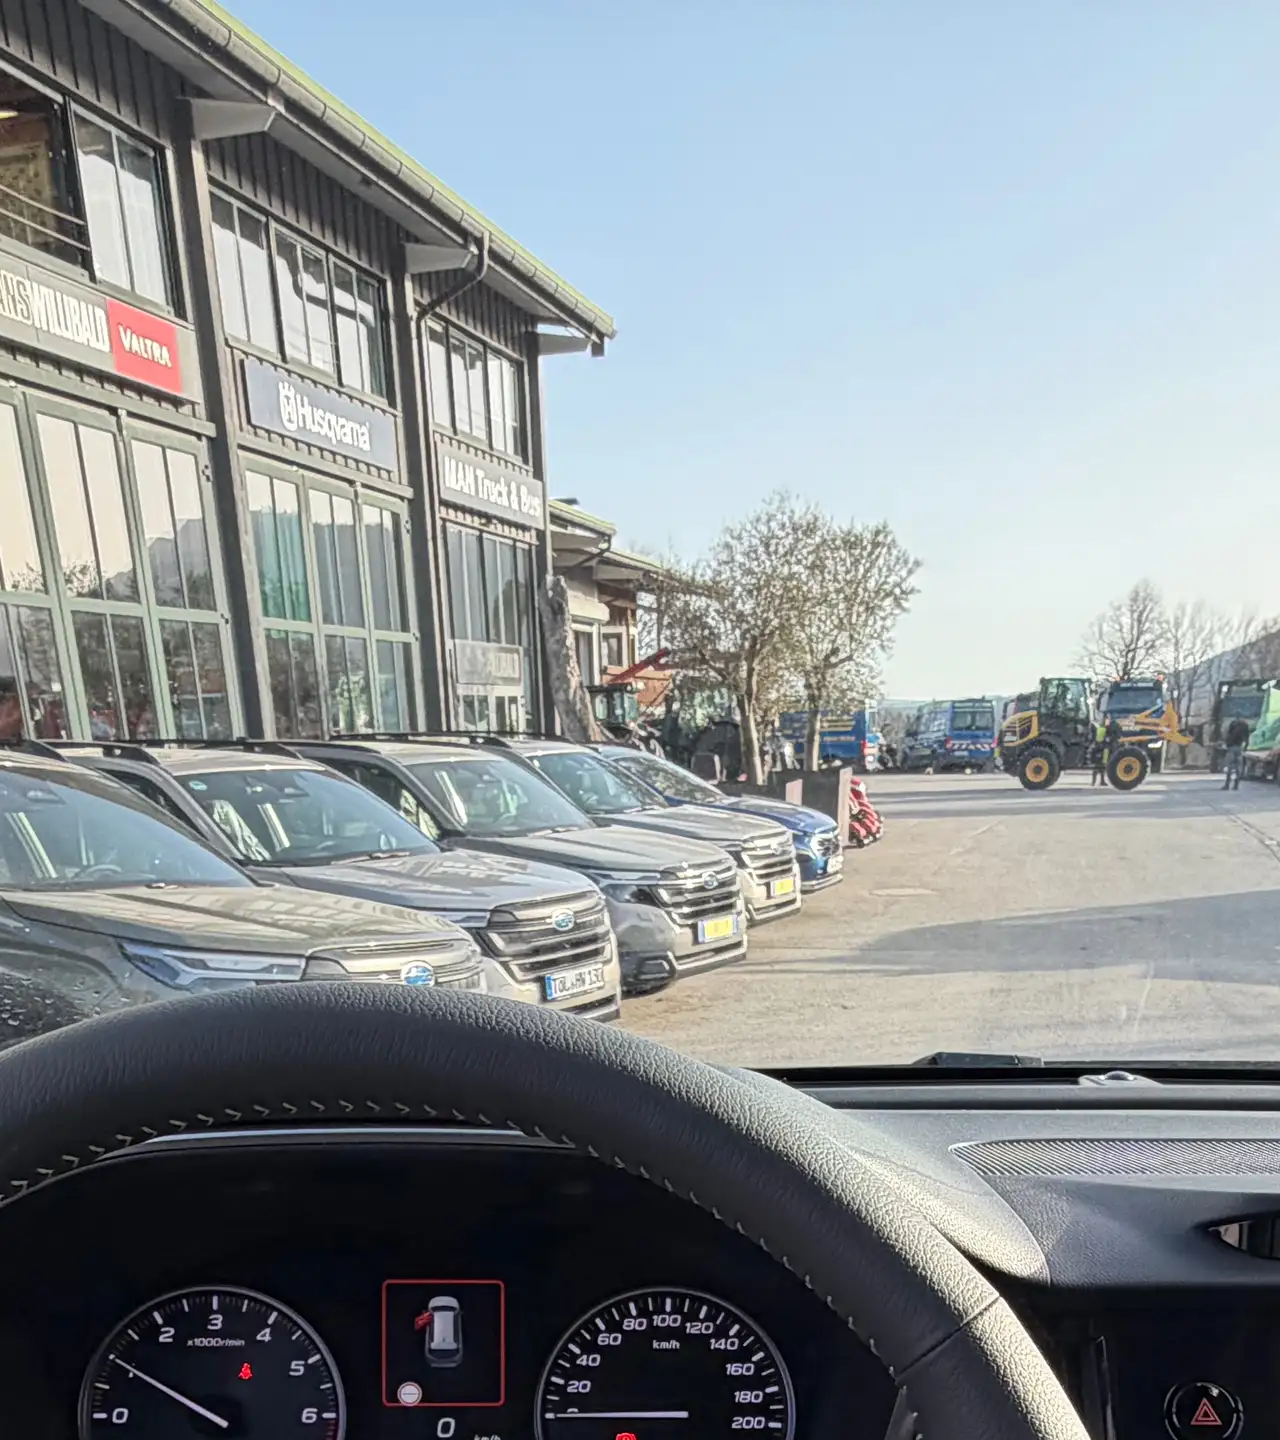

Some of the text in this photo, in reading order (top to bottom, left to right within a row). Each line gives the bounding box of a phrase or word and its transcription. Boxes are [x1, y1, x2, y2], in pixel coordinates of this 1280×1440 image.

[118, 323, 172, 368] VALTRA
[297, 395, 371, 451] Husqvarna
[443, 455, 542, 517] MAN Truck & Bus
[207, 1314, 223, 1330] 3
[622, 1317, 647, 1331] 80
[652, 1314, 682, 1328] 100
[685, 1321, 714, 1335] 120
[158, 1327, 175, 1342] 2
[255, 1328, 272, 1343] 4
[597, 1333, 621, 1347] 60
[652, 1339, 680, 1350] km/h
[709, 1337, 739, 1351] 140
[288, 1361, 306, 1376] 5
[576, 1354, 601, 1368] 40
[724, 1362, 755, 1377] 160
[567, 1380, 591, 1394] 20
[733, 1390, 764, 1404] 180
[111, 1407, 129, 1424] 0
[300, 1407, 318, 1423] 6
[436, 1417, 456, 1438] 0
[731, 1416, 766, 1430] 200
